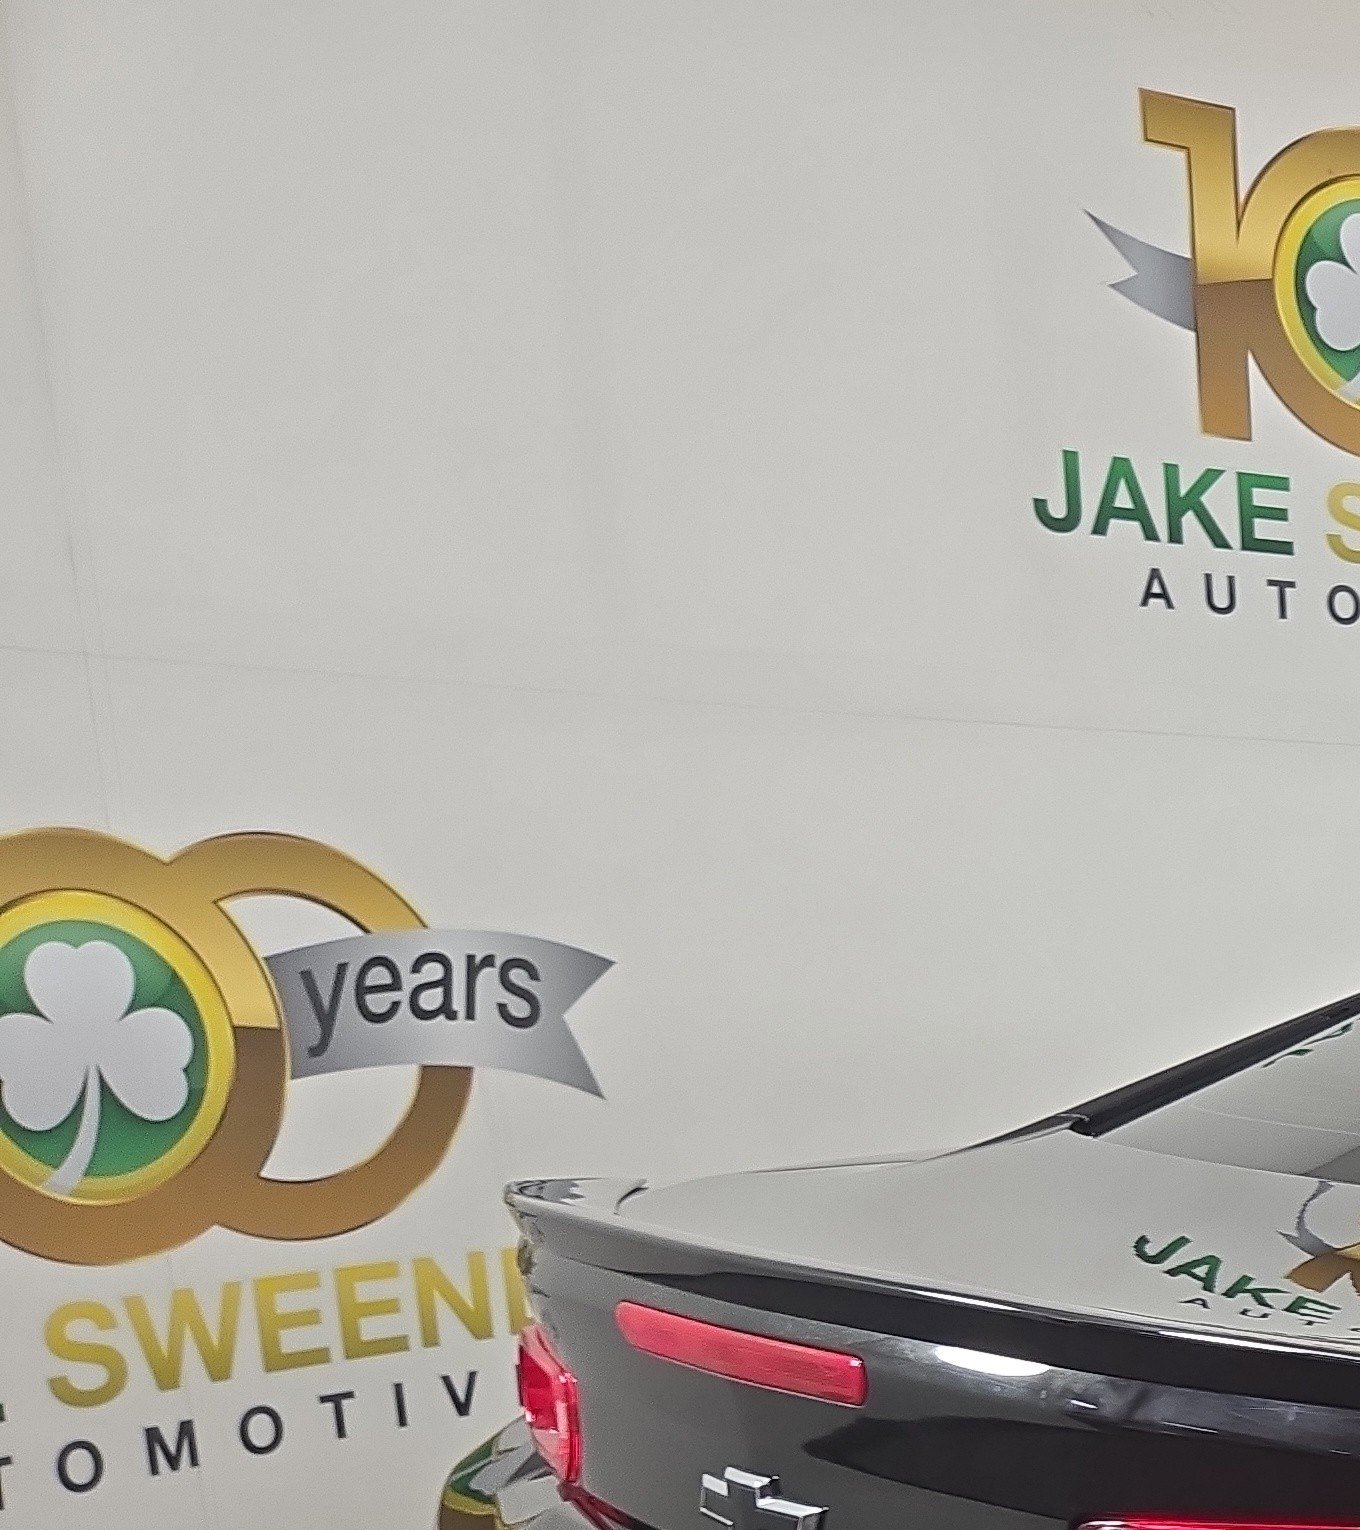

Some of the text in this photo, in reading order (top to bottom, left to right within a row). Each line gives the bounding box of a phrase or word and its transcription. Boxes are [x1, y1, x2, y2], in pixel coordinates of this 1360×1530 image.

[1032, 448, 1296, 556] JAKE
[300, 948, 543, 1058] years
[43, 1247, 534, 1409] SWEEN
[0, 1370, 478, 1511] OMOTIV
